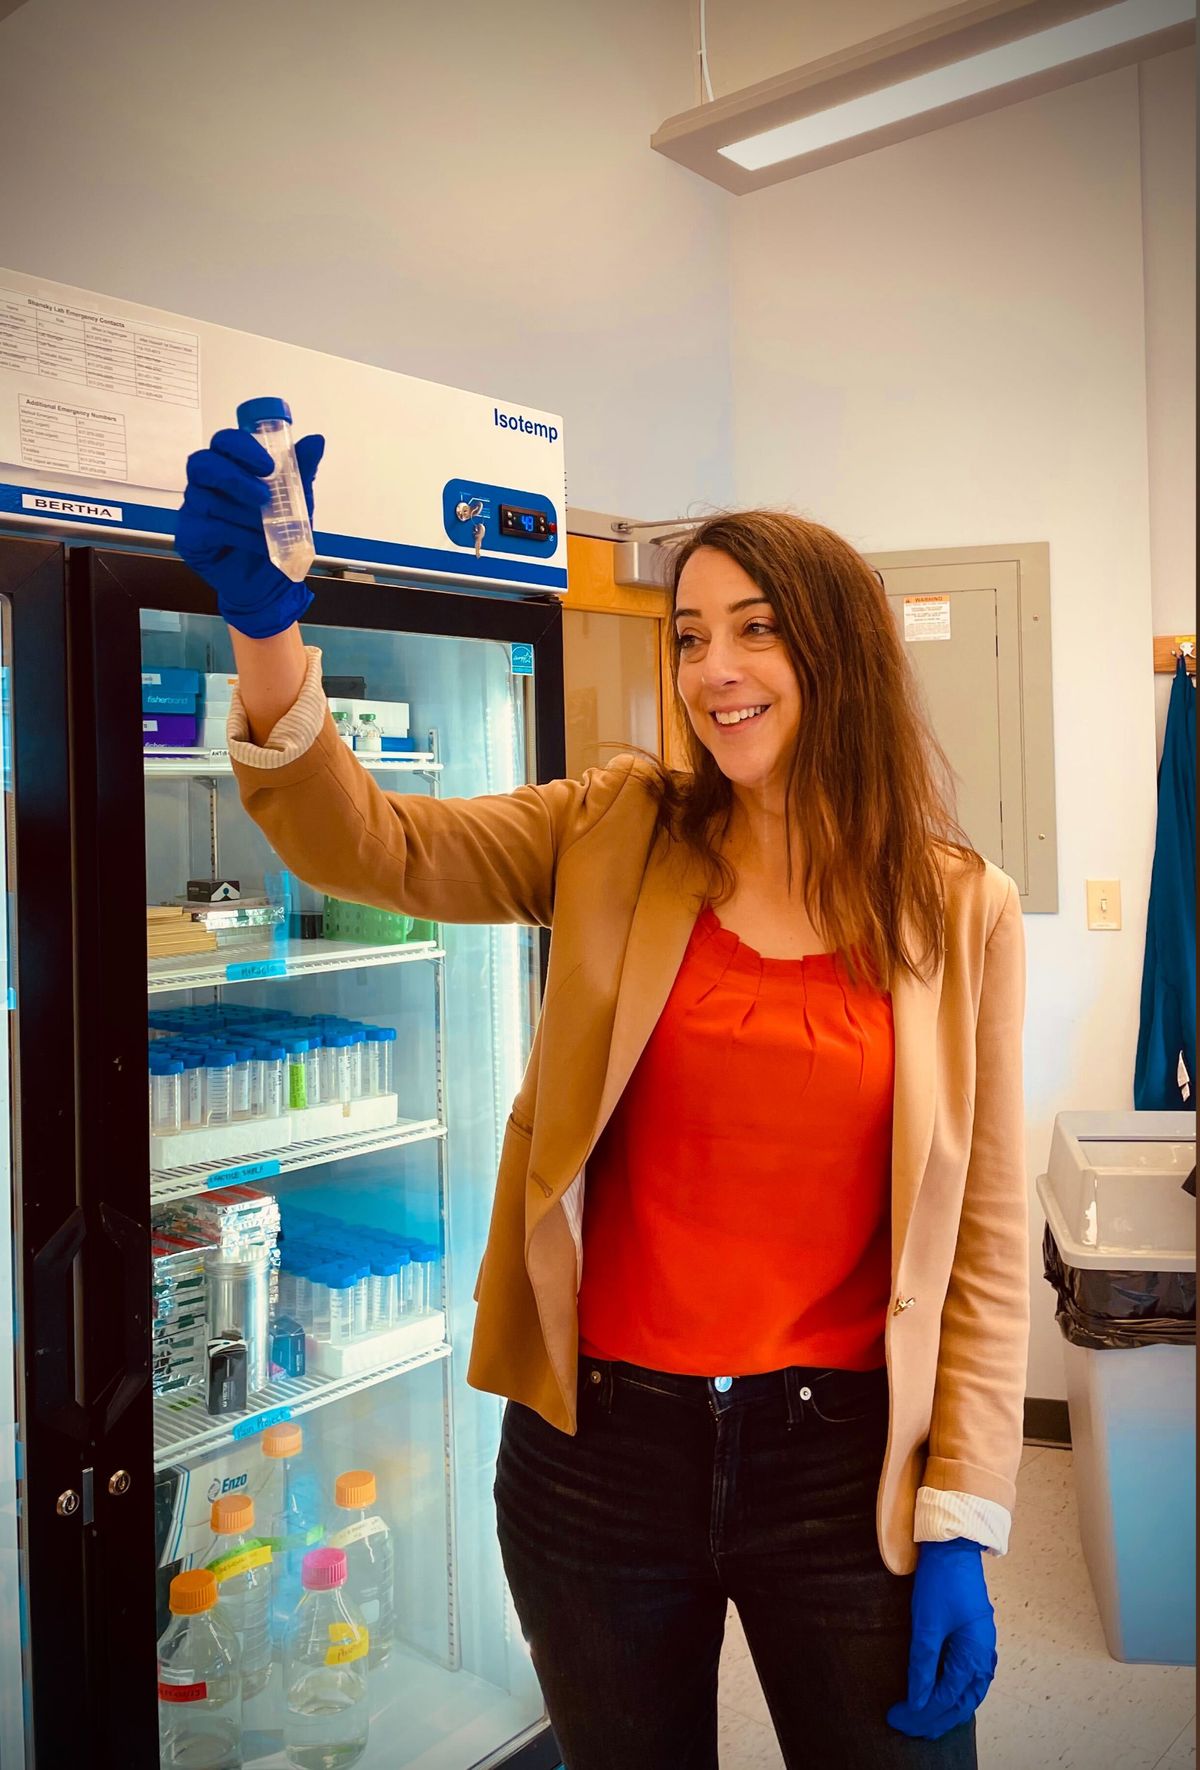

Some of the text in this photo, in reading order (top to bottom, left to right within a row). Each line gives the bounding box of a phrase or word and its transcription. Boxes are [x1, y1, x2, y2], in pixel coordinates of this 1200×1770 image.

[53, 306, 65, 315] Lab
[66, 309, 98, 323] Emergency
[99, 317, 125, 328] Contacts
[26, 399, 117, 422] Additional Emergency Numbers
[494, 408, 558, 443] Isotemp
[34, 498, 112, 518] BERTHA
[148, 695, 189, 704] fisherbrand
[221, 1473, 248, 1494] Enzo
